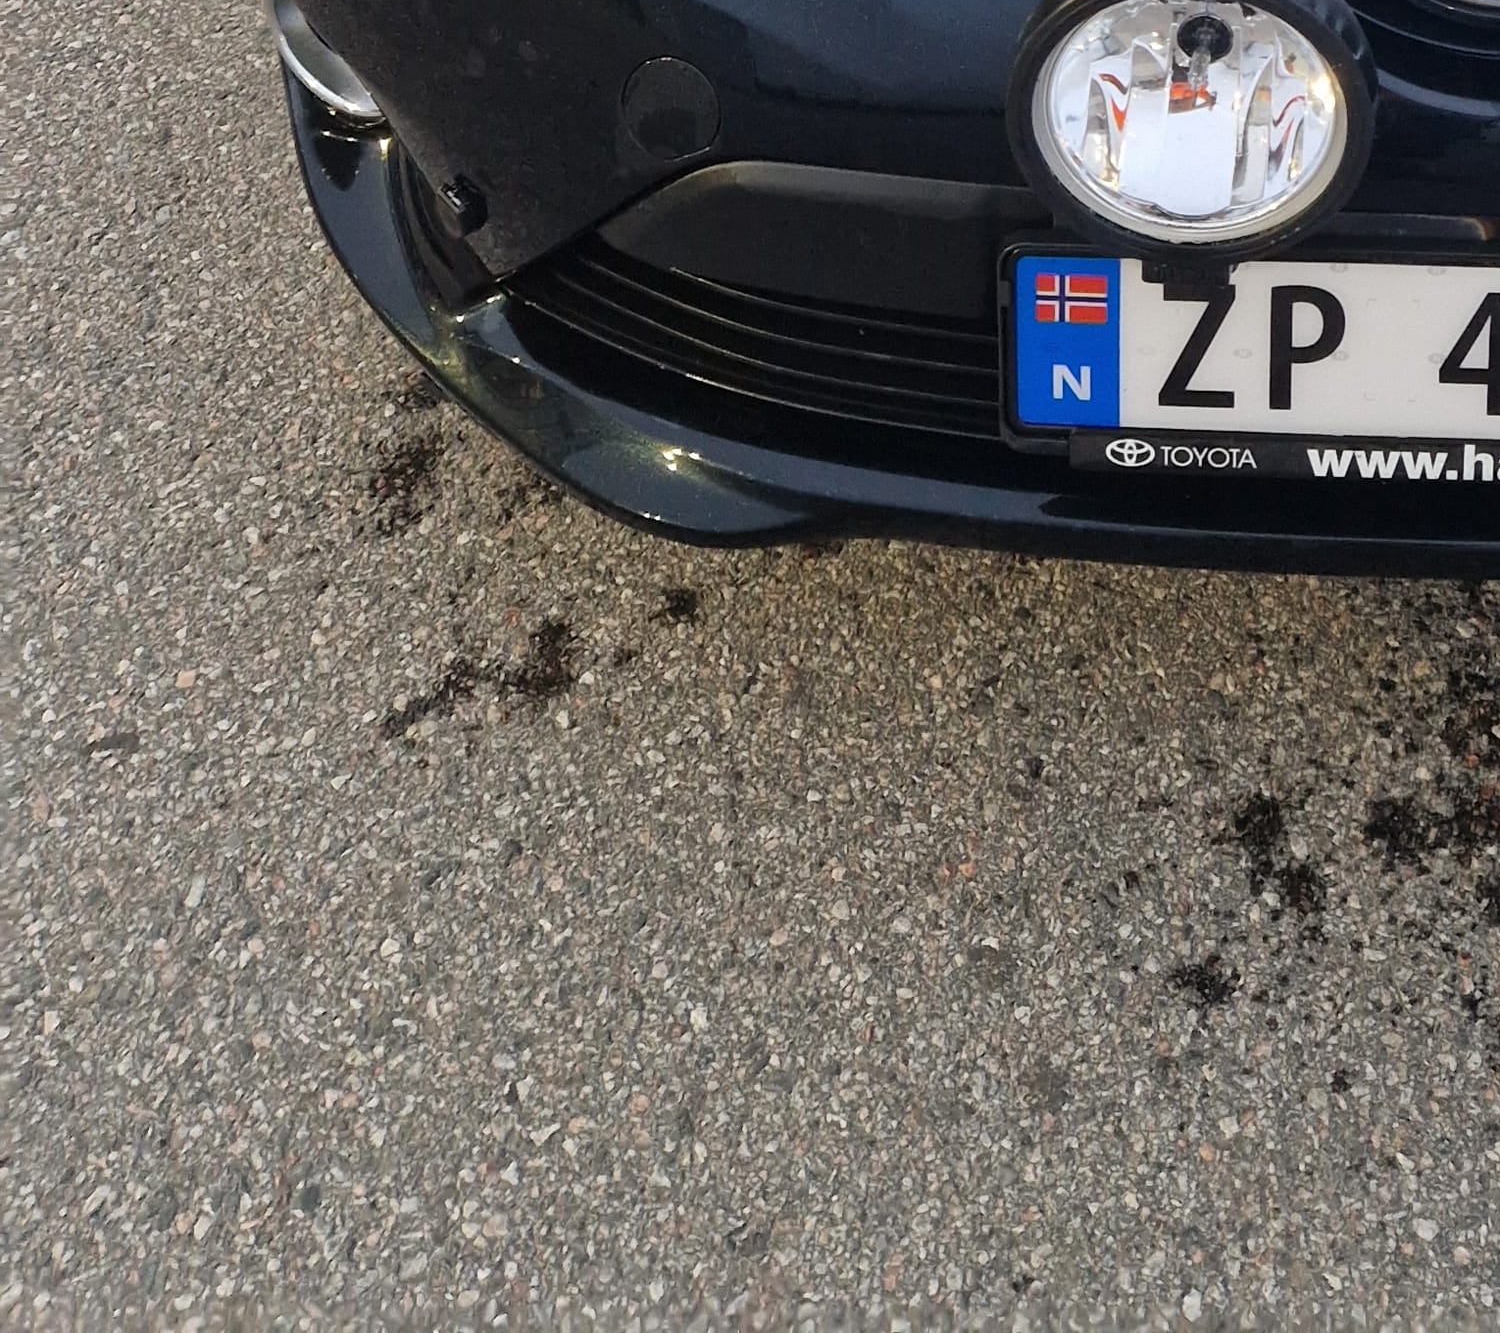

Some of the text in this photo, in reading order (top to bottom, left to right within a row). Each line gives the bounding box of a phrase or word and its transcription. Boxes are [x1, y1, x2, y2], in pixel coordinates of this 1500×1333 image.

[1158, 283, 1346, 410] ZP
[1052, 364, 1091, 401] N
[1160, 445, 1258, 469] TOYOTA
